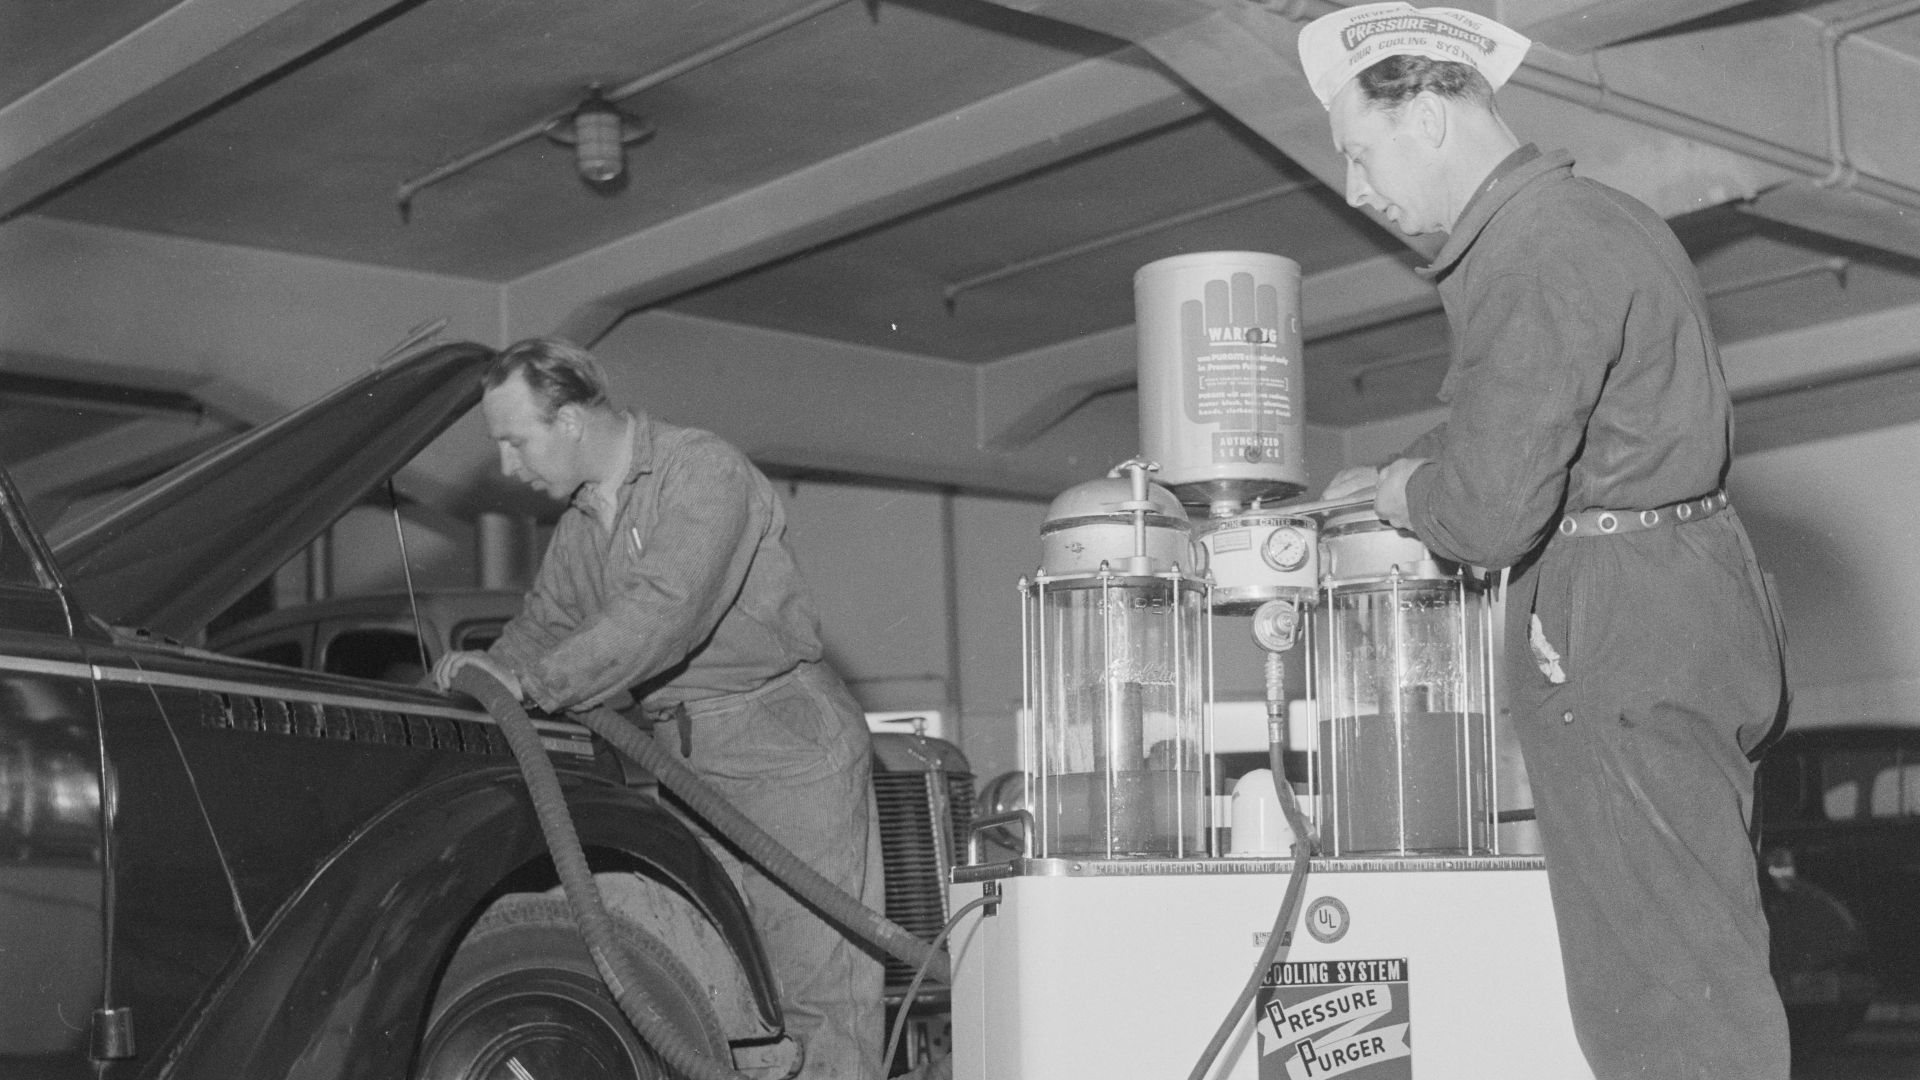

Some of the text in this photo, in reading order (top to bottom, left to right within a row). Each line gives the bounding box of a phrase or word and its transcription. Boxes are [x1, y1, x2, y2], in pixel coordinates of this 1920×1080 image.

[1378, 37, 1427, 51] COOLING
[1318, 908, 1337, 929] UL
[1337, 960, 1400, 982] SYSTEM
[1266, 989, 1378, 1040] PRESSURE
[1297, 1036, 1386, 1078] PURGER
